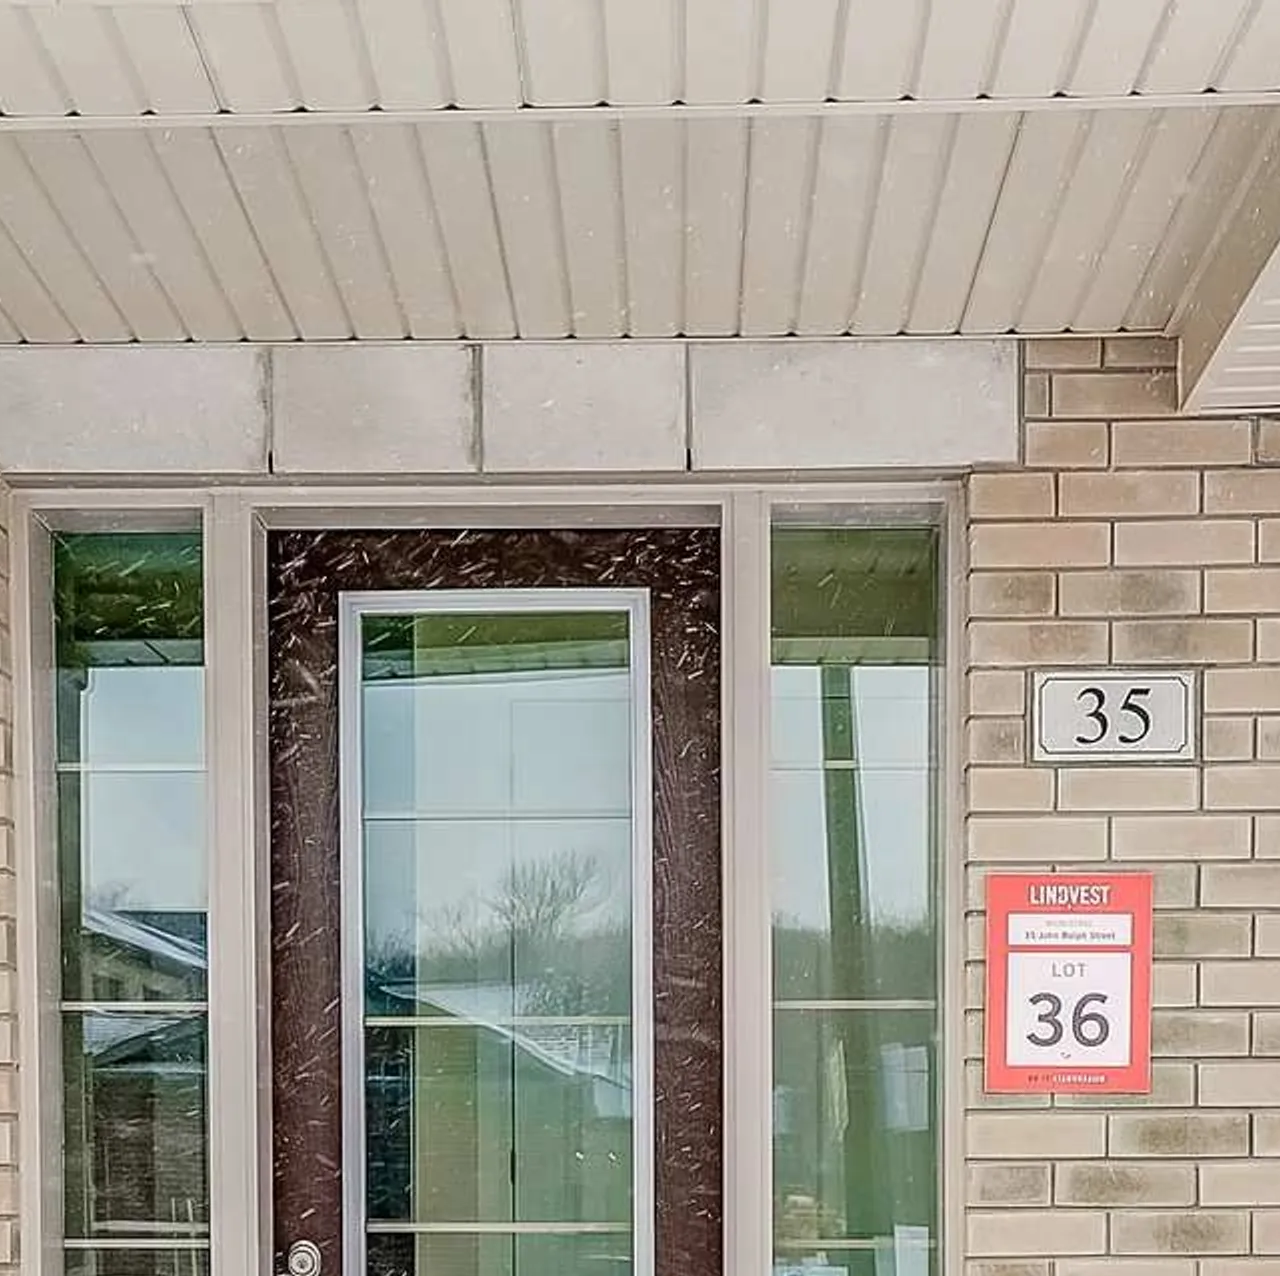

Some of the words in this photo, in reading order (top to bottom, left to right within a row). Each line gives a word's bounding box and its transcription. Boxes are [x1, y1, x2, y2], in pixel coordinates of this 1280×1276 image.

[1076, 688, 1151, 744] 35
[1029, 885, 1111, 905] LINDVEST
[1051, 963, 1088, 978] LOT
[1026, 992, 1110, 1048] 36
